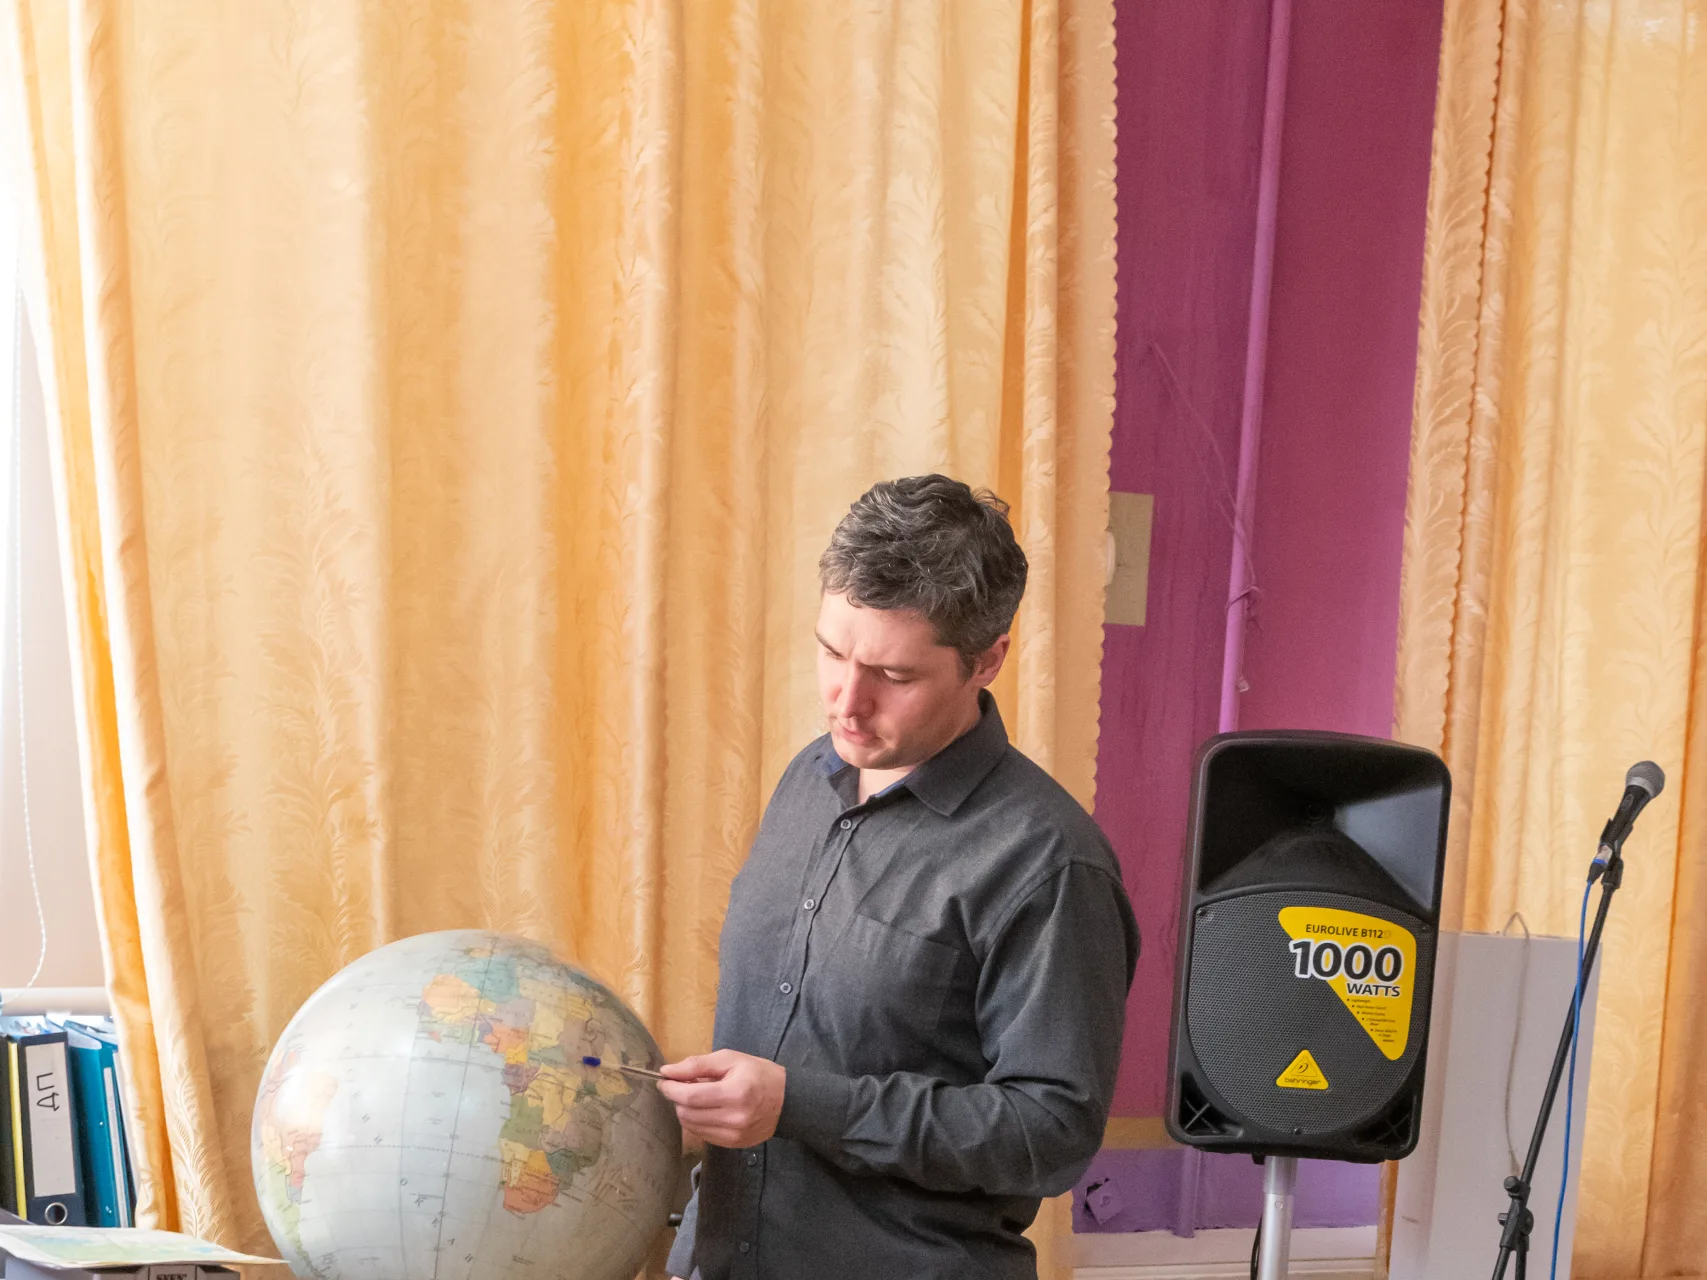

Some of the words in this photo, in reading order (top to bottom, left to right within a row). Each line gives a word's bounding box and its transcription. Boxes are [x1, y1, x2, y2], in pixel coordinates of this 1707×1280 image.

[1305, 923, 1359, 937] EUROLIVE
[1291, 940, 1403, 982] 1000
[1346, 983, 1401, 997] WATTS
[1284, 1077, 1321, 1087] behringer
